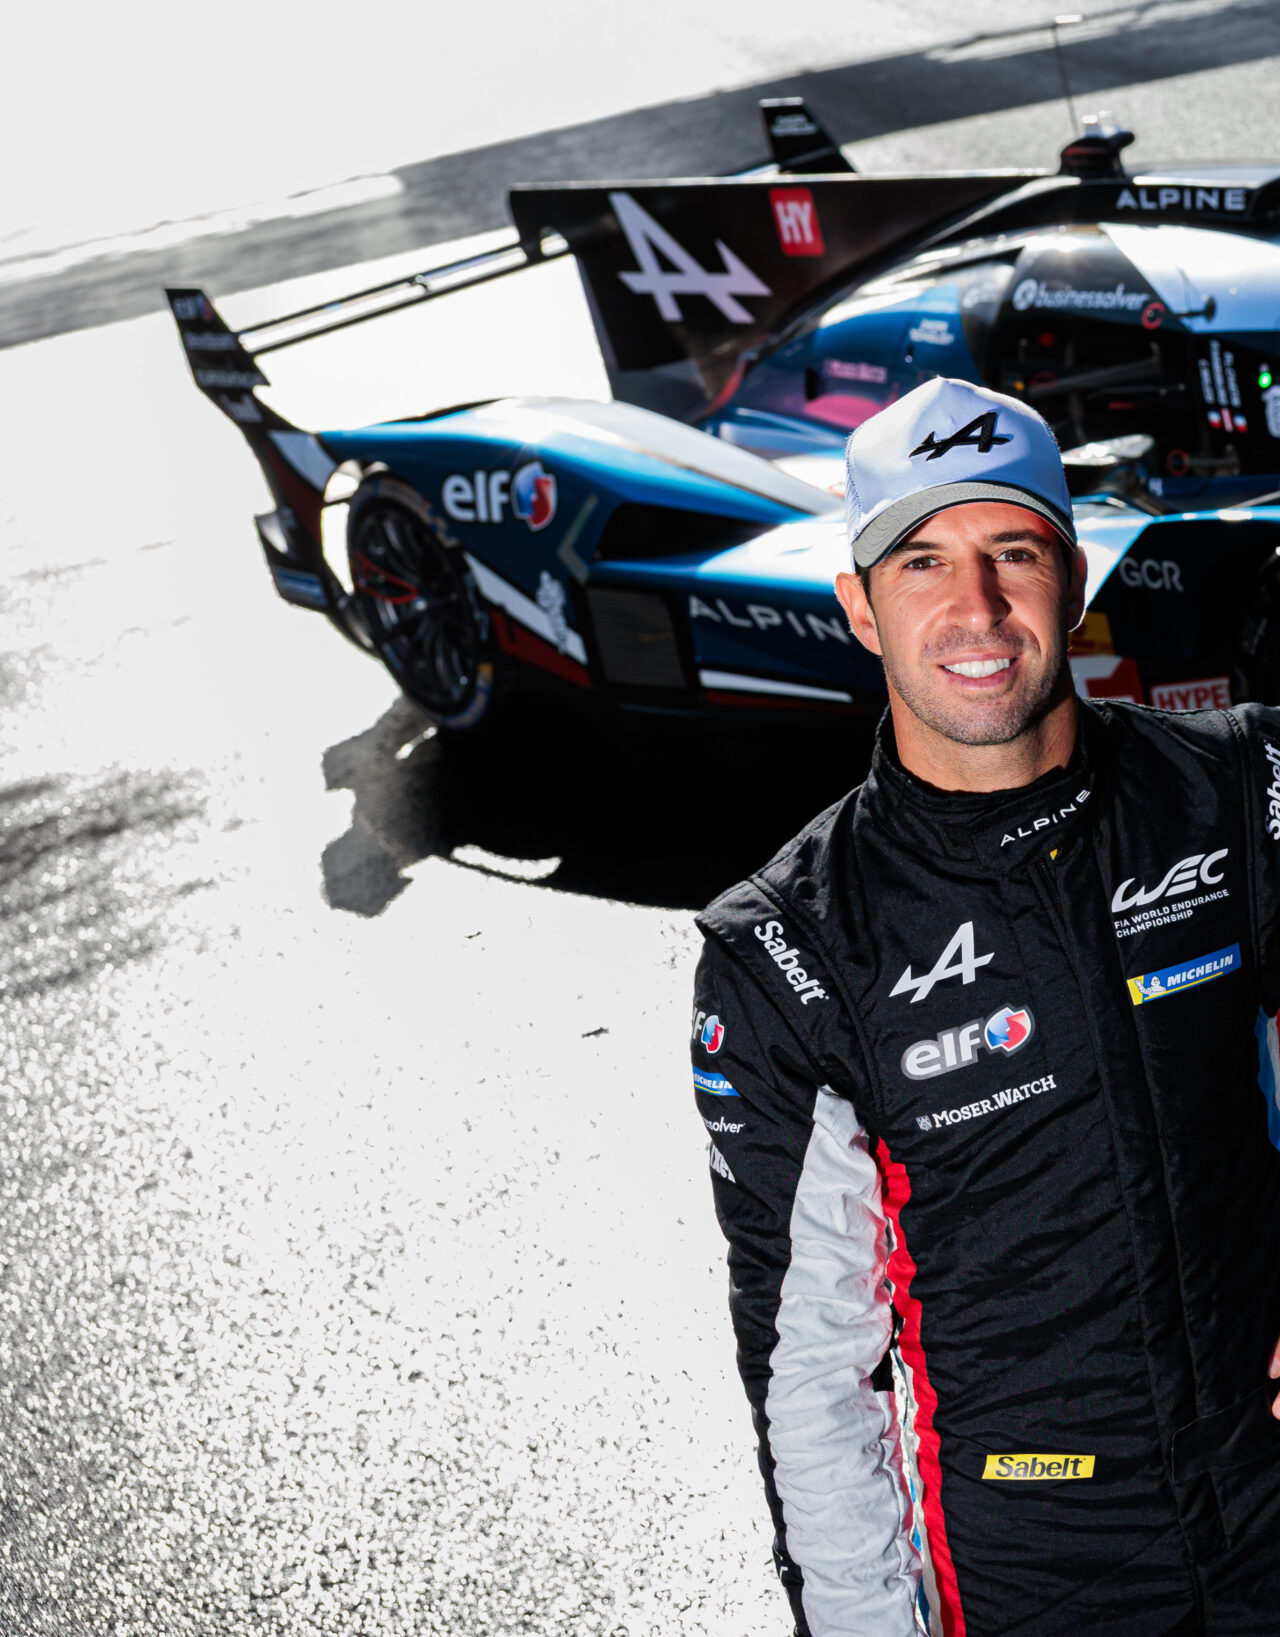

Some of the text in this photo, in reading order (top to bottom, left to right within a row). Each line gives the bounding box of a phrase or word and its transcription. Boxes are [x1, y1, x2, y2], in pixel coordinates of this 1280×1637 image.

[775, 201, 814, 245] HY
[1115, 188, 1247, 211] ALPINE
[441, 469, 511, 523] elf
[1119, 556, 1184, 592] GCR
[689, 594, 852, 645] ALPIN
[1000, 789, 1091, 847] ALPINE
[1111, 847, 1229, 913] WEC
[1114, 888, 1230, 930] FIA WORLD ENDURANCE
[1116, 909, 1194, 938] CHAMPIONSHIP
[754, 920, 827, 1005] Sabelt
[1166, 954, 1234, 987] MICHELIN
[905, 1022, 980, 1076] elf
[932, 1074, 1057, 1129] MOSER.WATCH
[995, 1456, 1083, 1478] Sabelt
